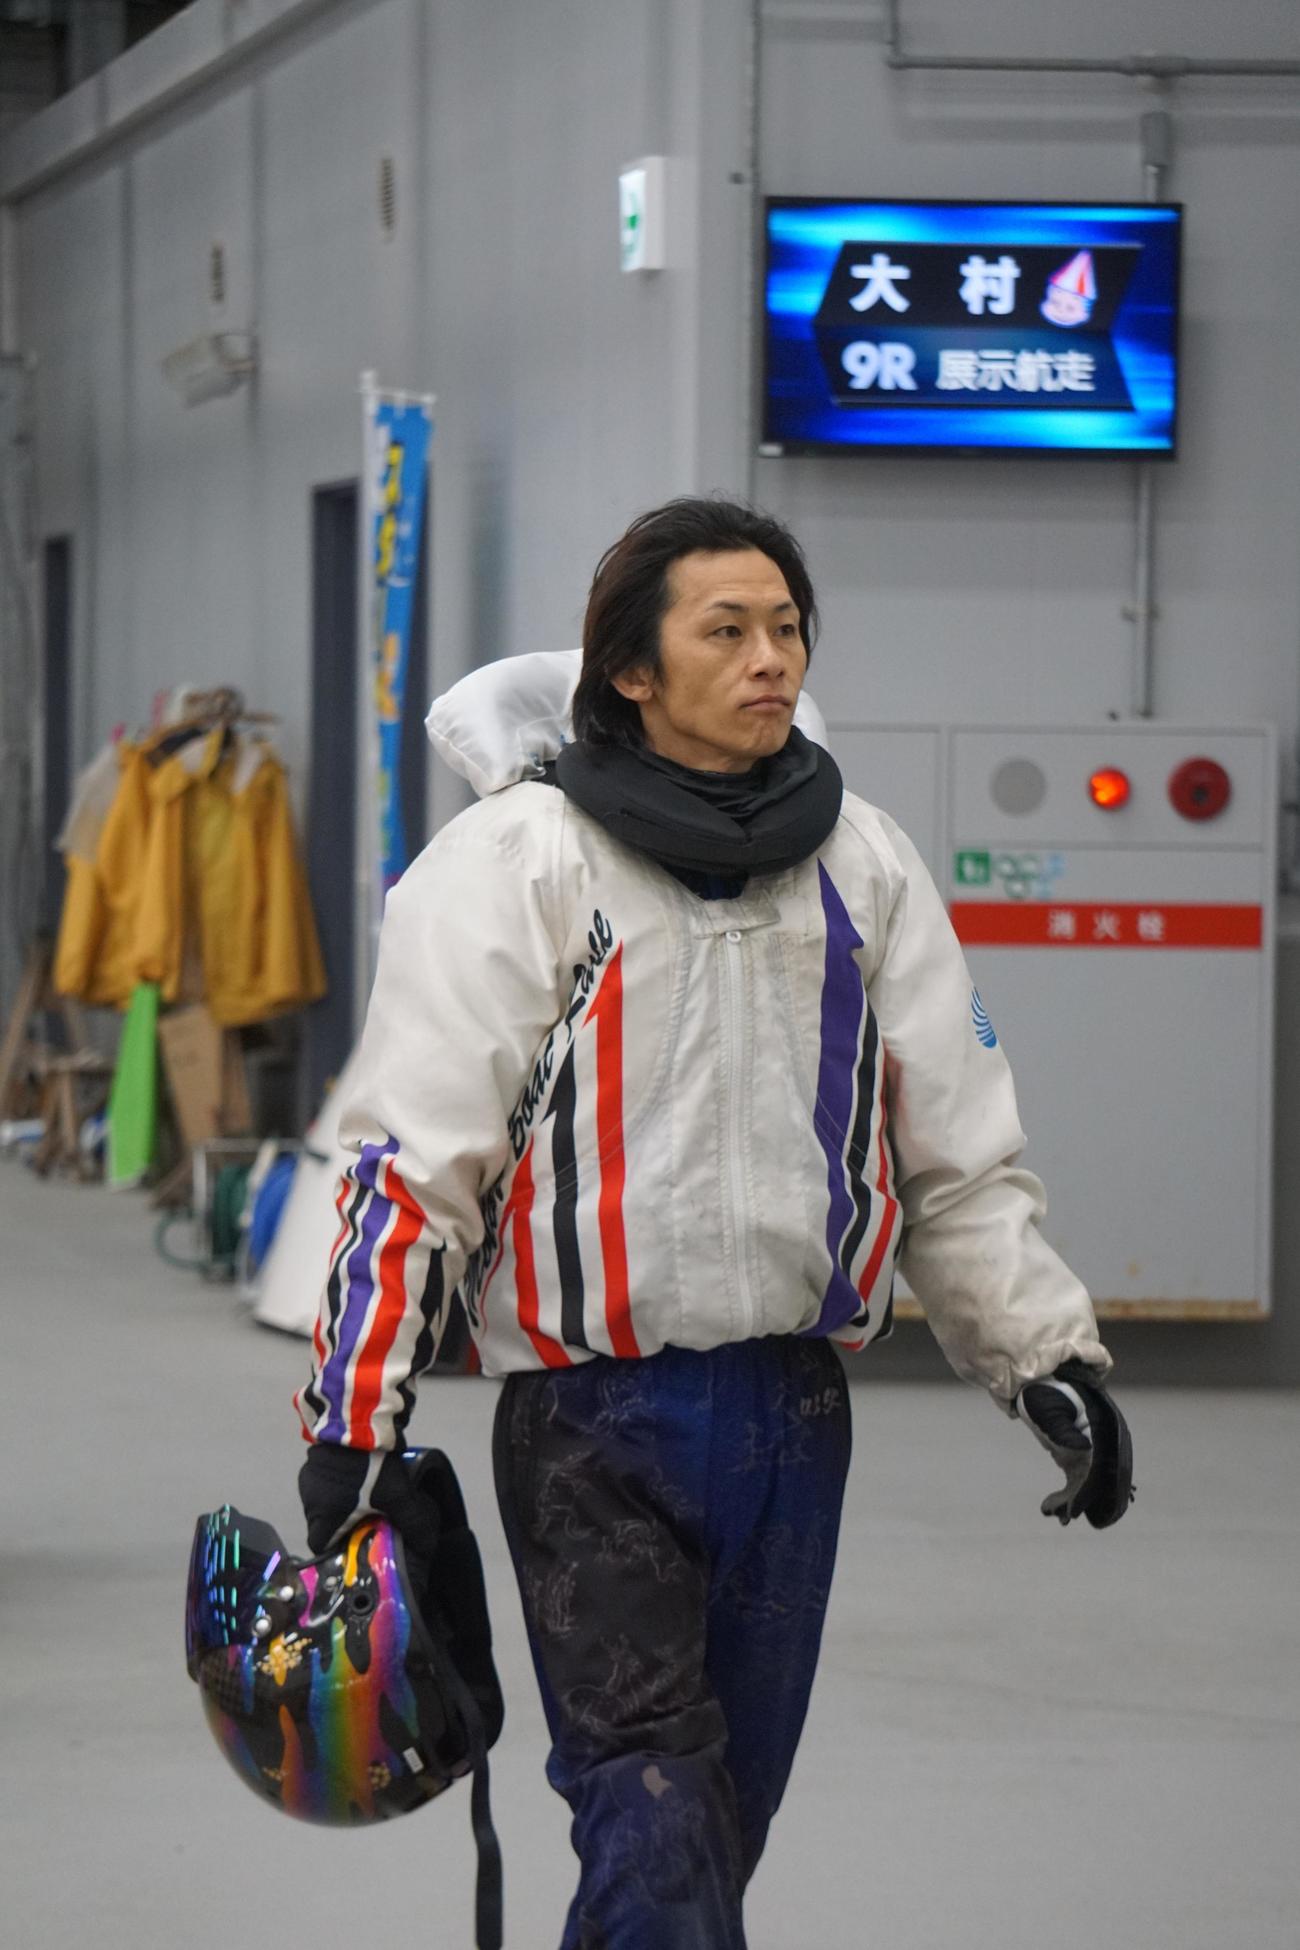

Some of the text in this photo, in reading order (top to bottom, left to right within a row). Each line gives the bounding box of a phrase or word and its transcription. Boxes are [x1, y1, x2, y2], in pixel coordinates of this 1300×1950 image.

[841, 341, 1096, 392] 9R 展示航走
